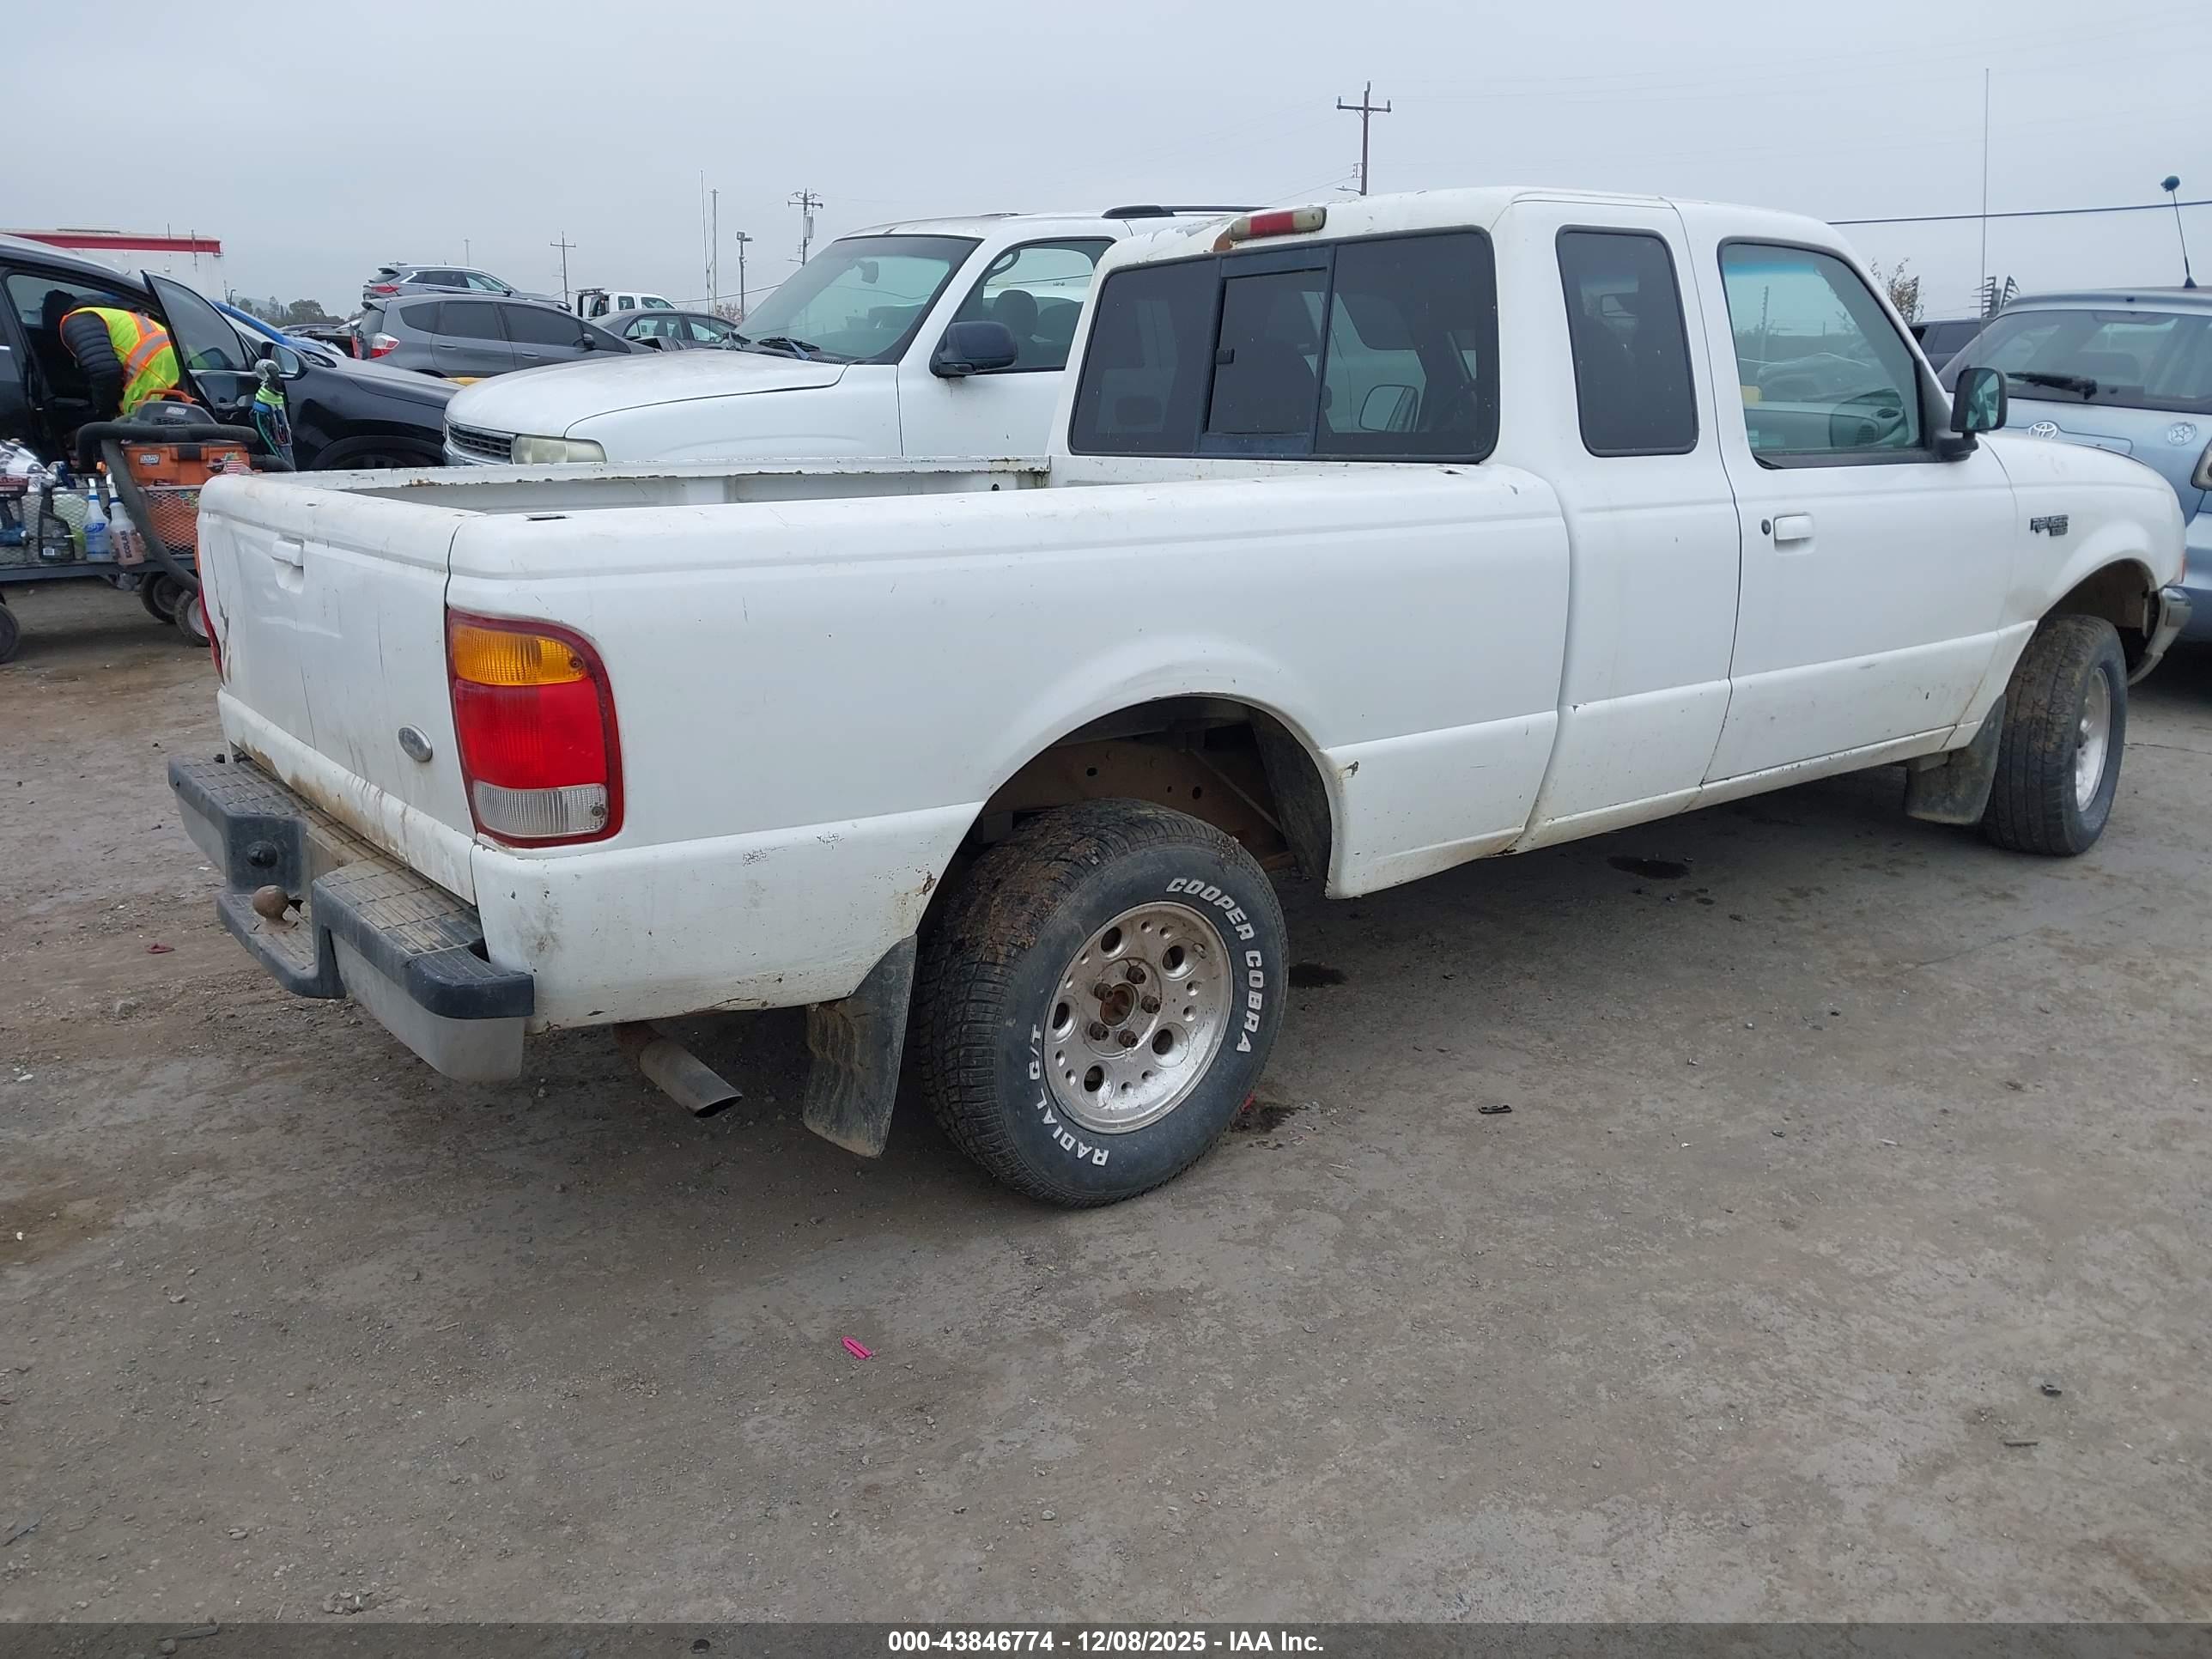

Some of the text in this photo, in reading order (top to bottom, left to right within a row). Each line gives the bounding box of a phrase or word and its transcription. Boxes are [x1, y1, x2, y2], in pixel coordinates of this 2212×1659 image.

[119, 530, 132, 558] ECOLAB
[1166, 878, 1264, 1053] COOPER COBRA
[1036, 1086, 1109, 1166] RADIAL
